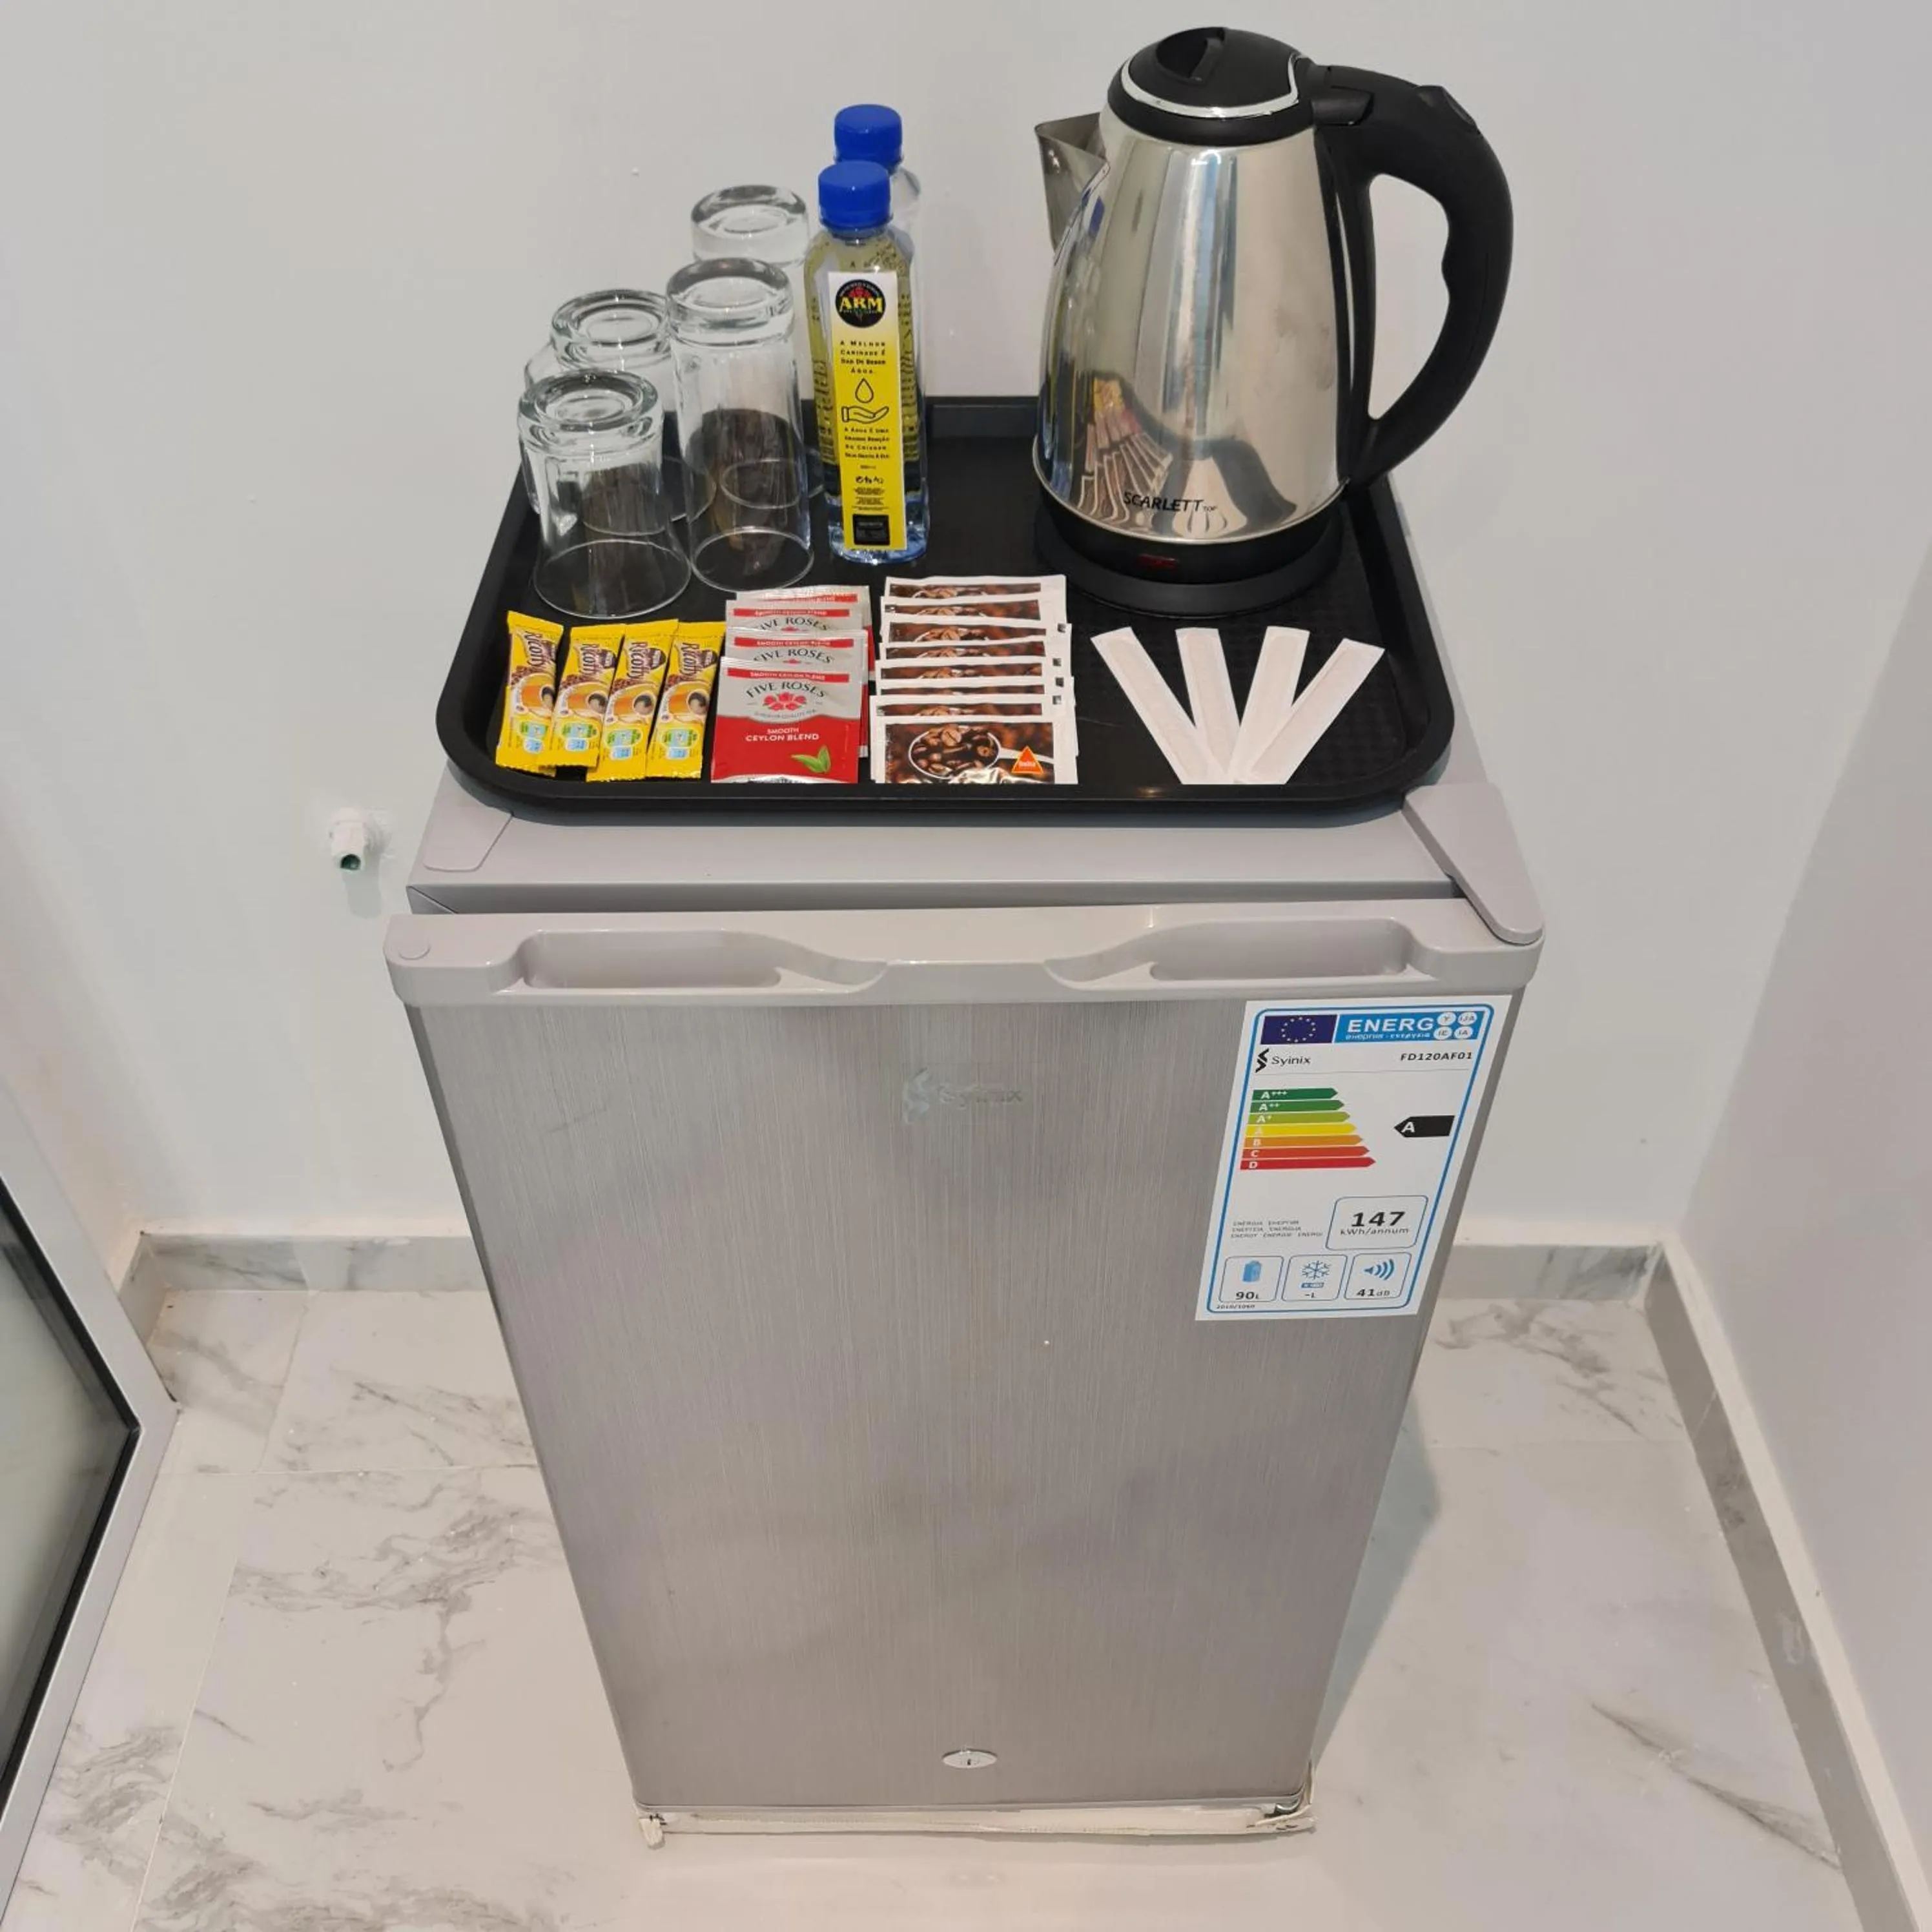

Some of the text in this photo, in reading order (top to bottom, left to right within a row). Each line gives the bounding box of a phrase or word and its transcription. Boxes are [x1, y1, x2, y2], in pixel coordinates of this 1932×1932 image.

[1124, 491, 1204, 512] SCARLETT
[759, 617, 827, 630] IVE ROSES
[787, 648, 831, 663] ROSES
[746, 681, 826, 698] FIVE ROSES
[745, 733, 819, 742] CEYLON BLEND
[1347, 1017, 1435, 1033] ENERG
[1271, 1055, 1311, 1067] Syinix
[1400, 1051, 1473, 1062] FD120AF01
[1401, 1122, 1417, 1133] A
[1253, 1138, 1262, 1147] B
[1250, 1149, 1260, 1158] C
[1350, 1211, 1406, 1227] 147
